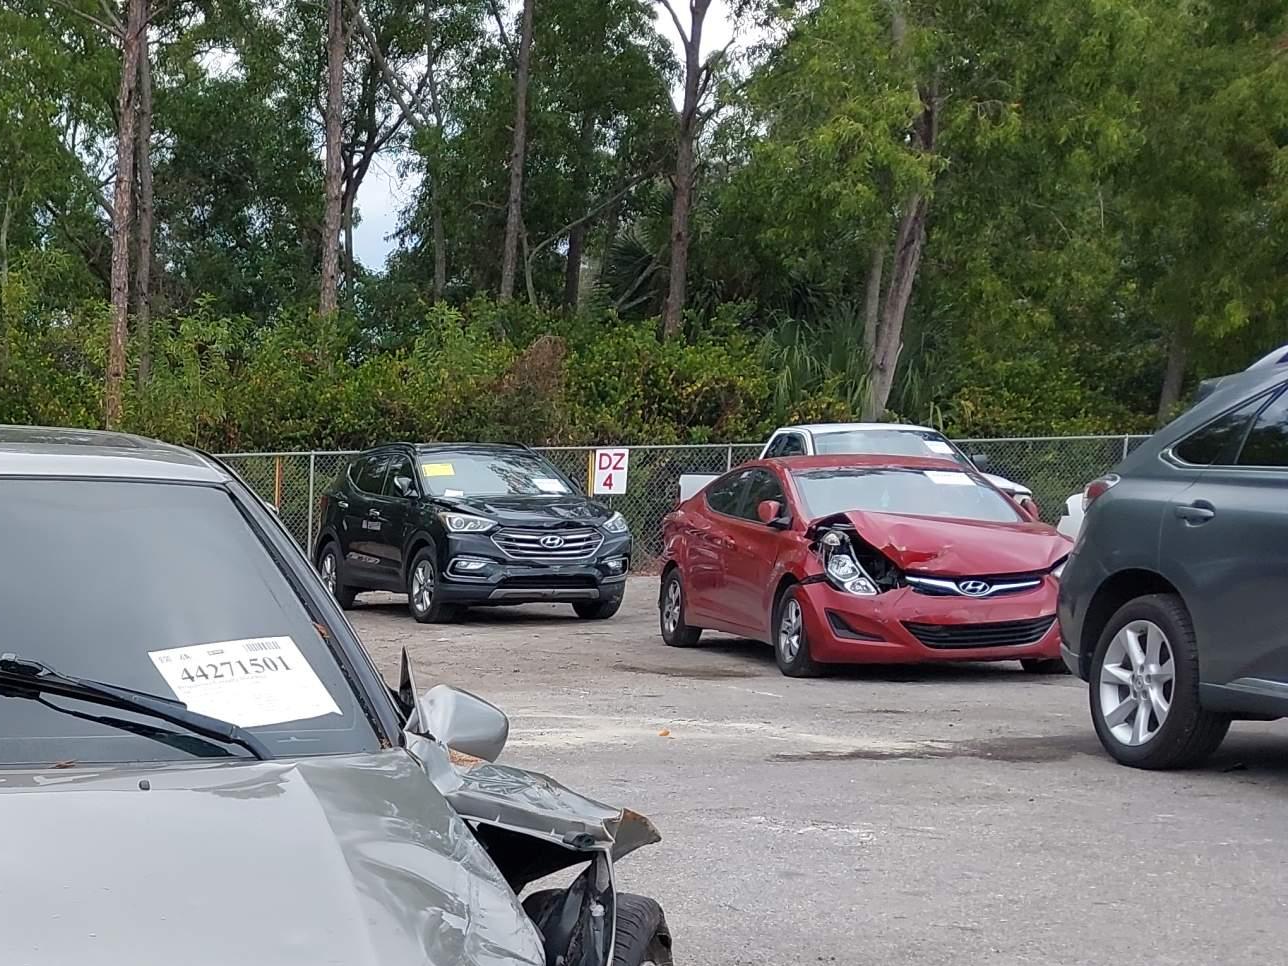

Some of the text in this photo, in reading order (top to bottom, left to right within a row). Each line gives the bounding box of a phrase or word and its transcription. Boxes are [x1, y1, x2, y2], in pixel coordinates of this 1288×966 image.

[599, 453, 625, 470] DZ
[602, 473, 613, 490] 4
[180, 655, 292, 682] 44271501
